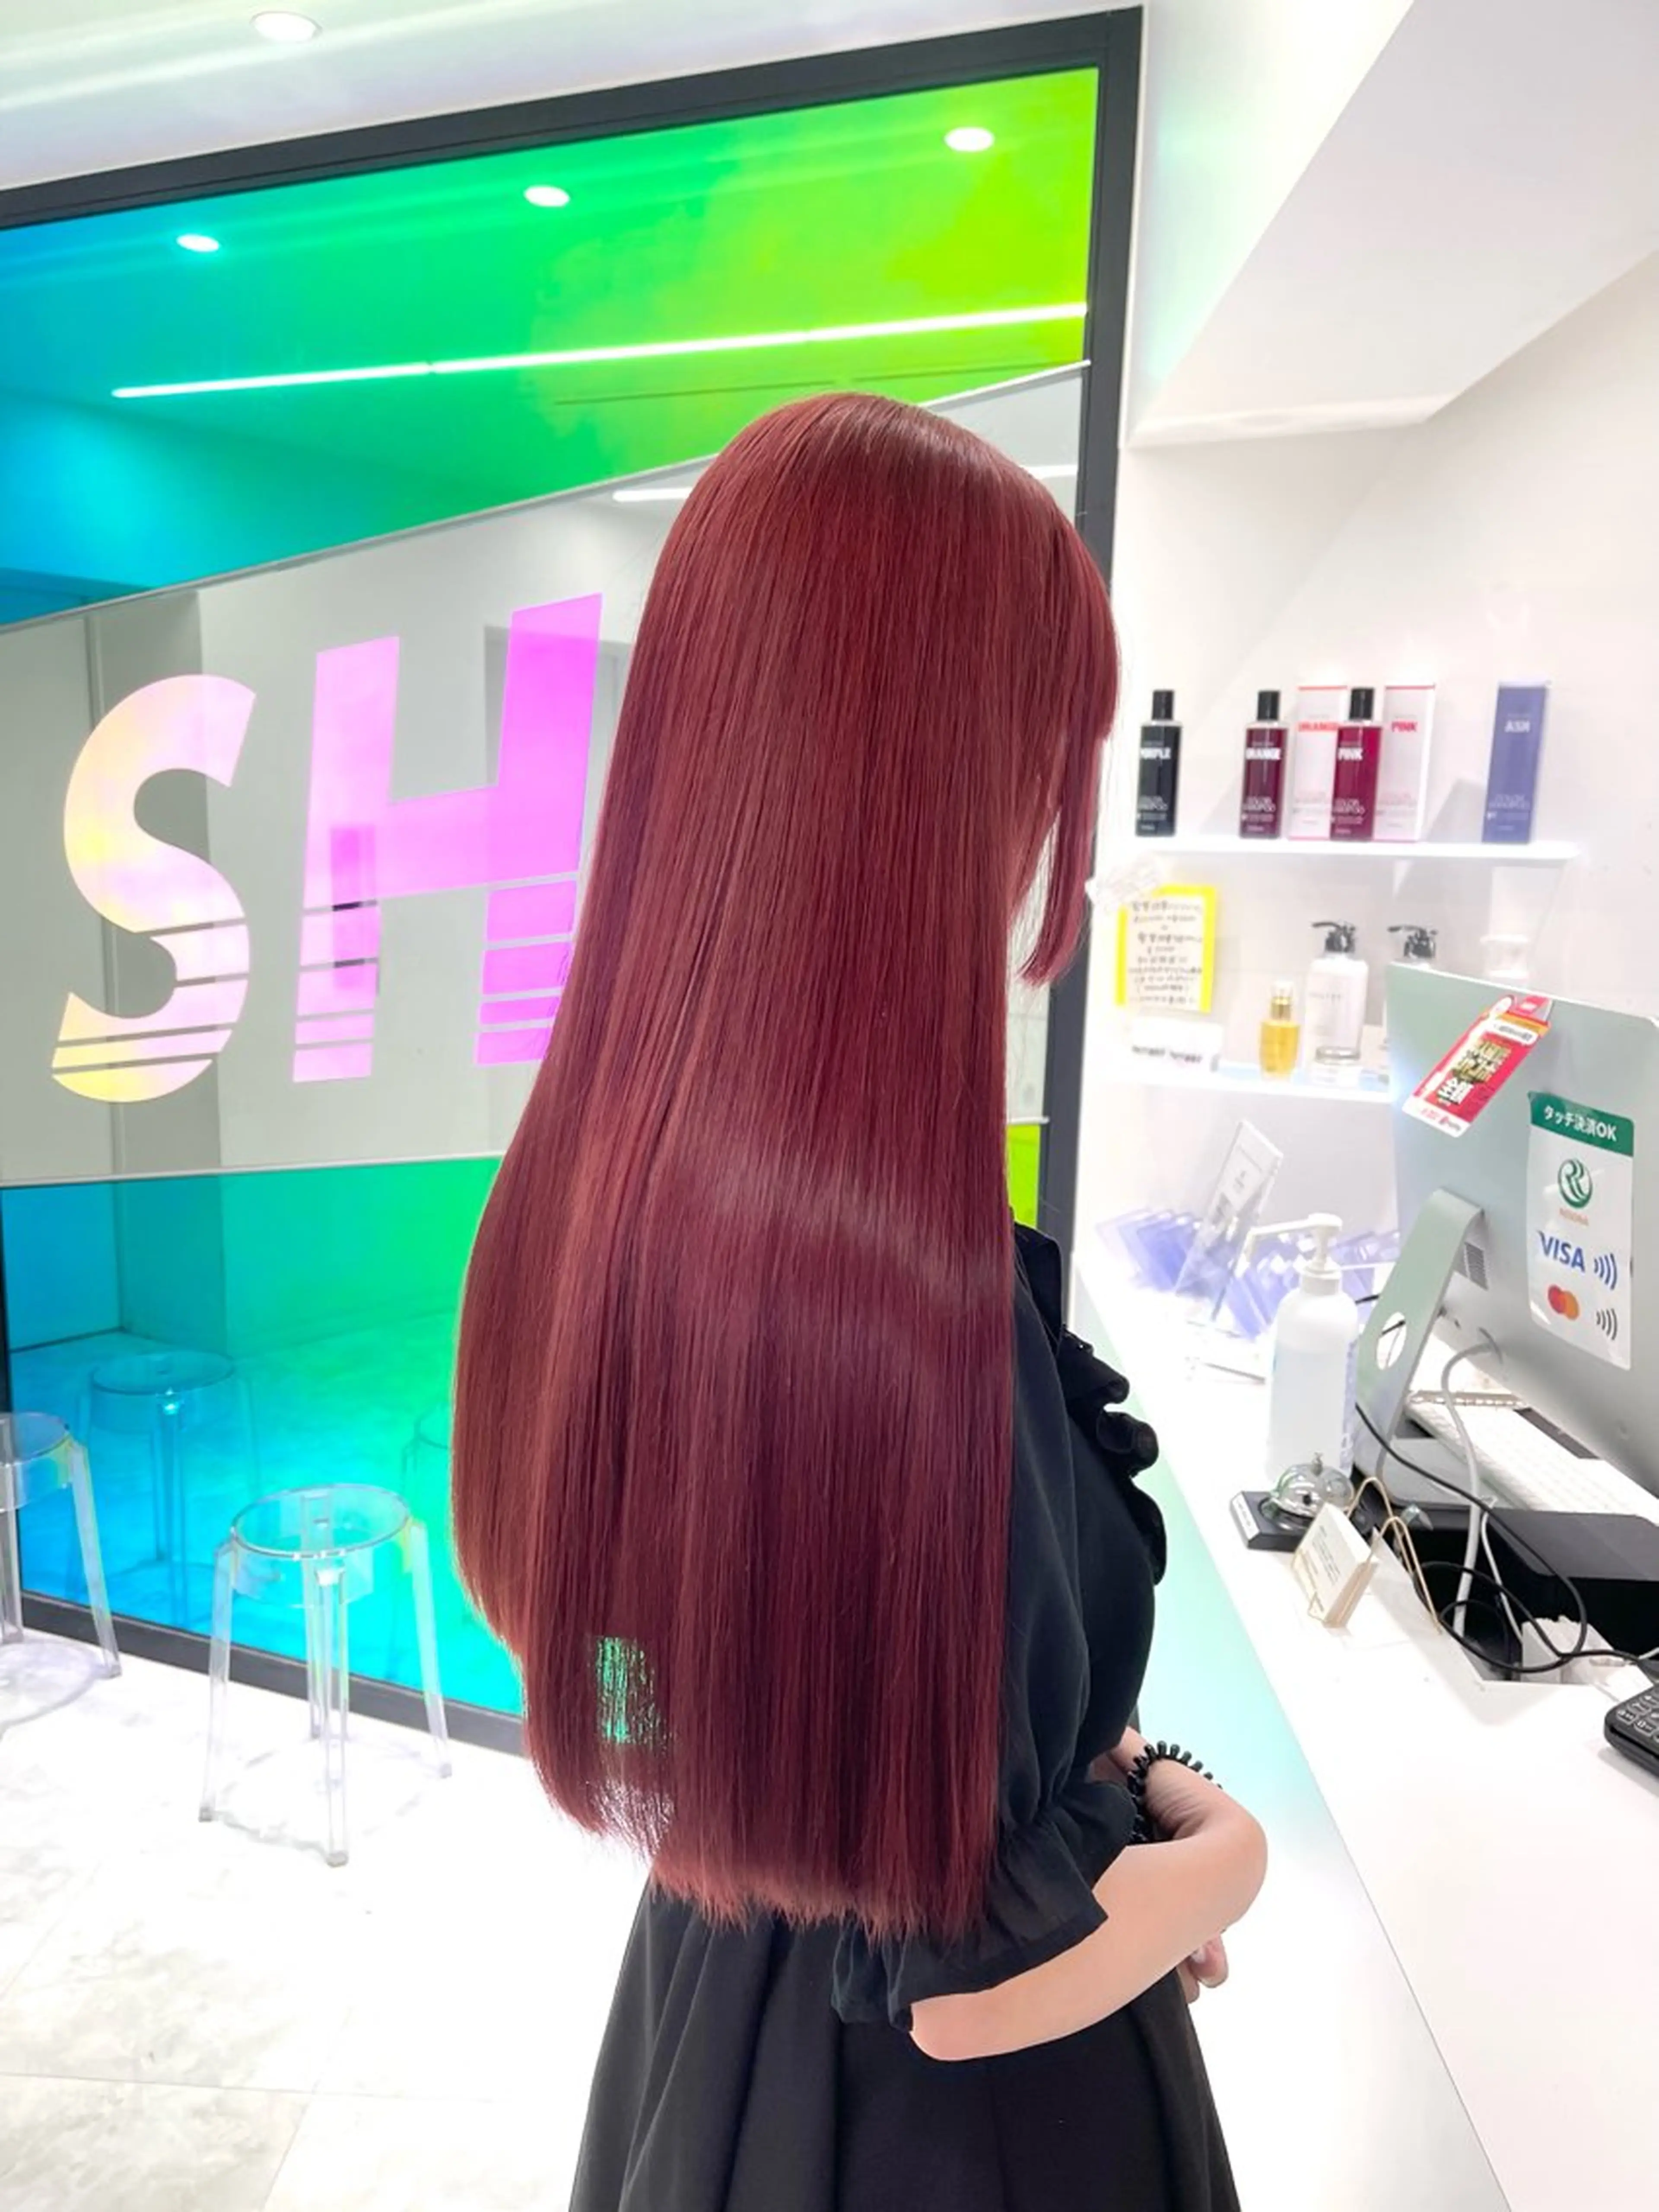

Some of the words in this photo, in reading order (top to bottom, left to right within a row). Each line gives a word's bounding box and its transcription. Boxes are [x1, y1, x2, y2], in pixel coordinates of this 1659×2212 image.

[1544, 1105, 1617, 1142] タッチ決済OK
[1537, 1230, 1586, 1273] VISA
